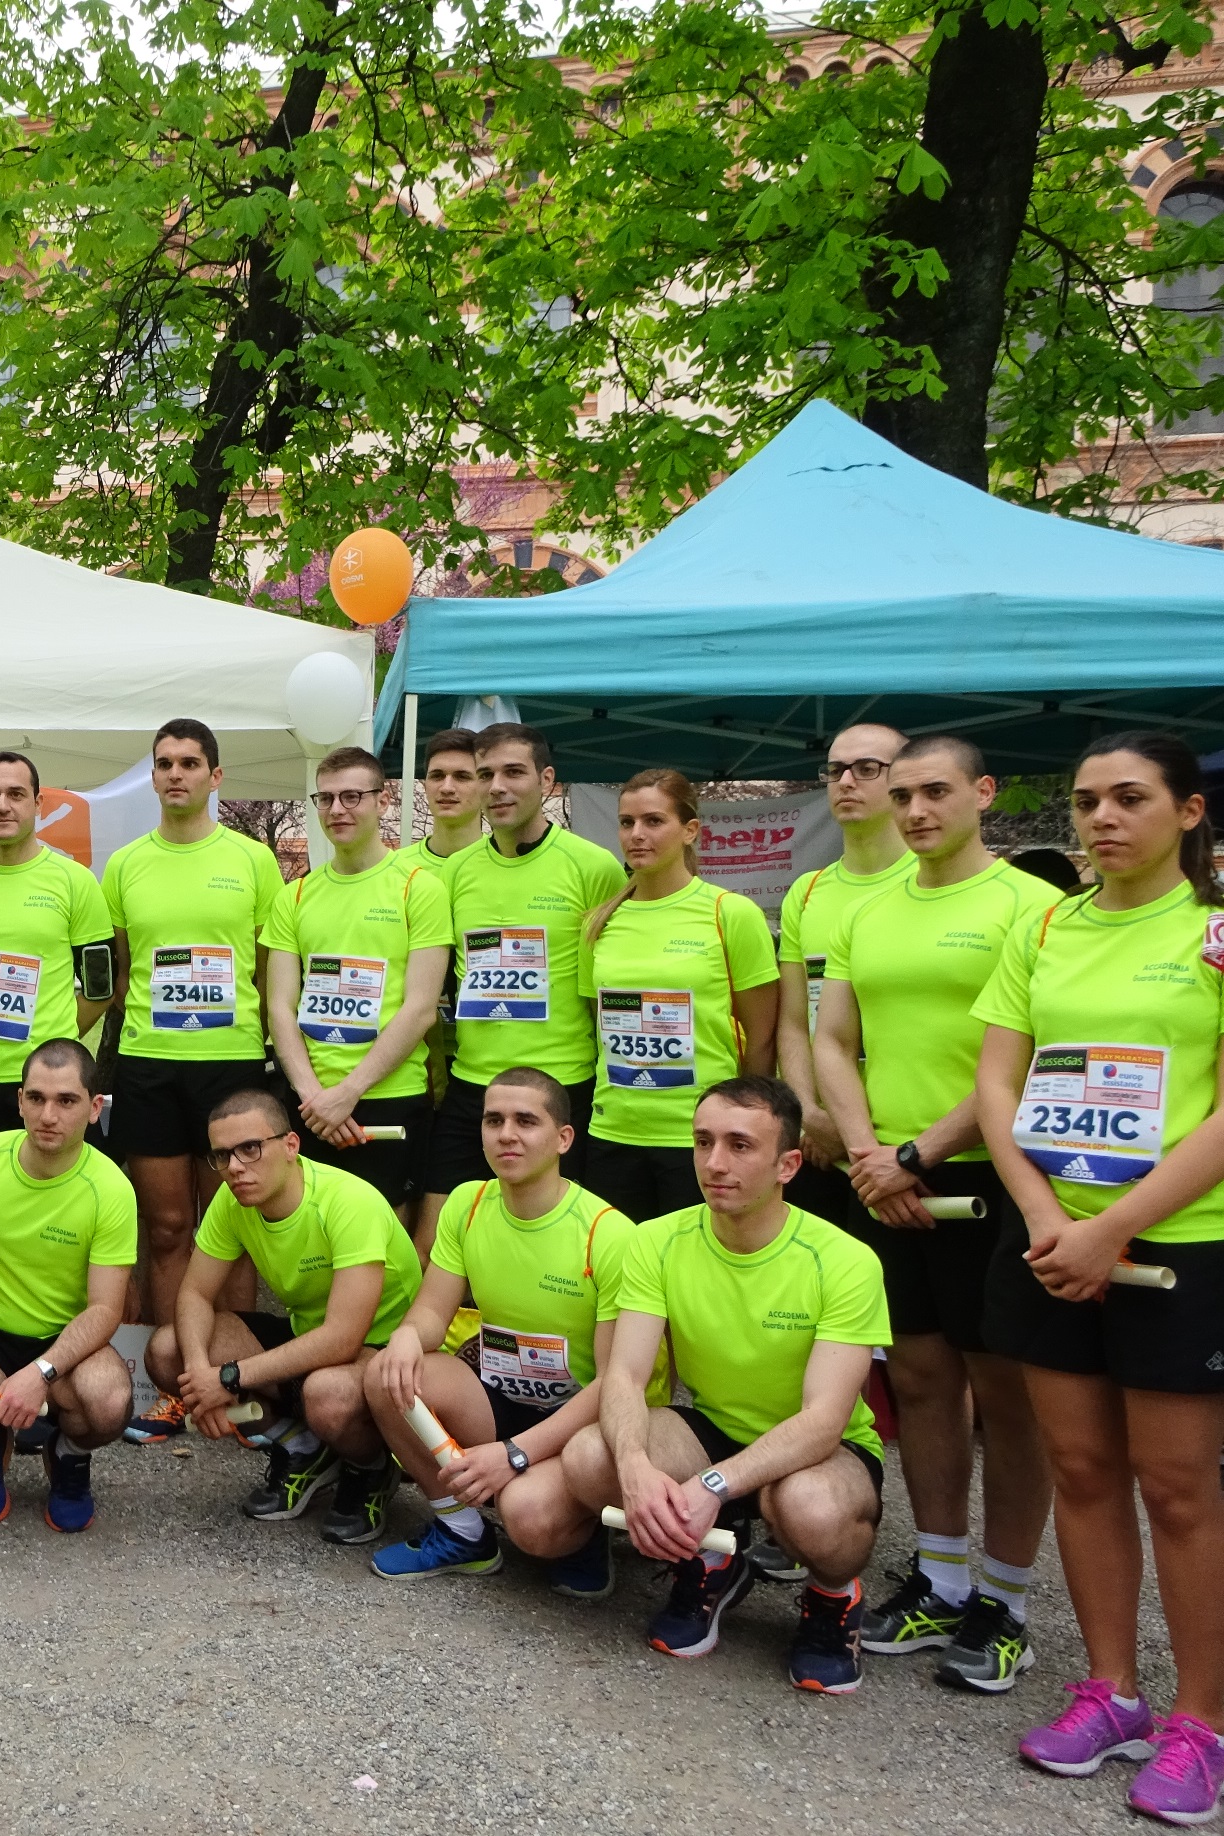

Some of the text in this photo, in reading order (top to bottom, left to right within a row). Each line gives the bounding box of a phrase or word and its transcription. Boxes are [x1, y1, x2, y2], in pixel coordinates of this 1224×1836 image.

[469, 936, 499, 946] SuisseGas
[157, 953, 189, 961] SuisseGas
[468, 970, 538, 990] 2322C
[162, 985, 223, 1002] 2341B
[307, 995, 372, 1017] 2309C
[603, 997, 640, 1006] SuisseGas
[609, 1034, 682, 1059] 2353C
[1037, 1056, 1083, 1067] SuisseGas
[1115, 1055, 1160, 1063] MARATHON
[1118, 1073, 1144, 1081] europ
[1030, 1105, 1140, 1140] 2341C
[1061, 1170, 1095, 1179] adidas
[544, 1274, 578, 1287] ACCADEMIA
[539, 1282, 556, 1293] Guardia
[768, 1311, 809, 1319] ACCADEMIA
[484, 1333, 516, 1348] SuisseGas
[490, 1375, 570, 1399] 2338C
